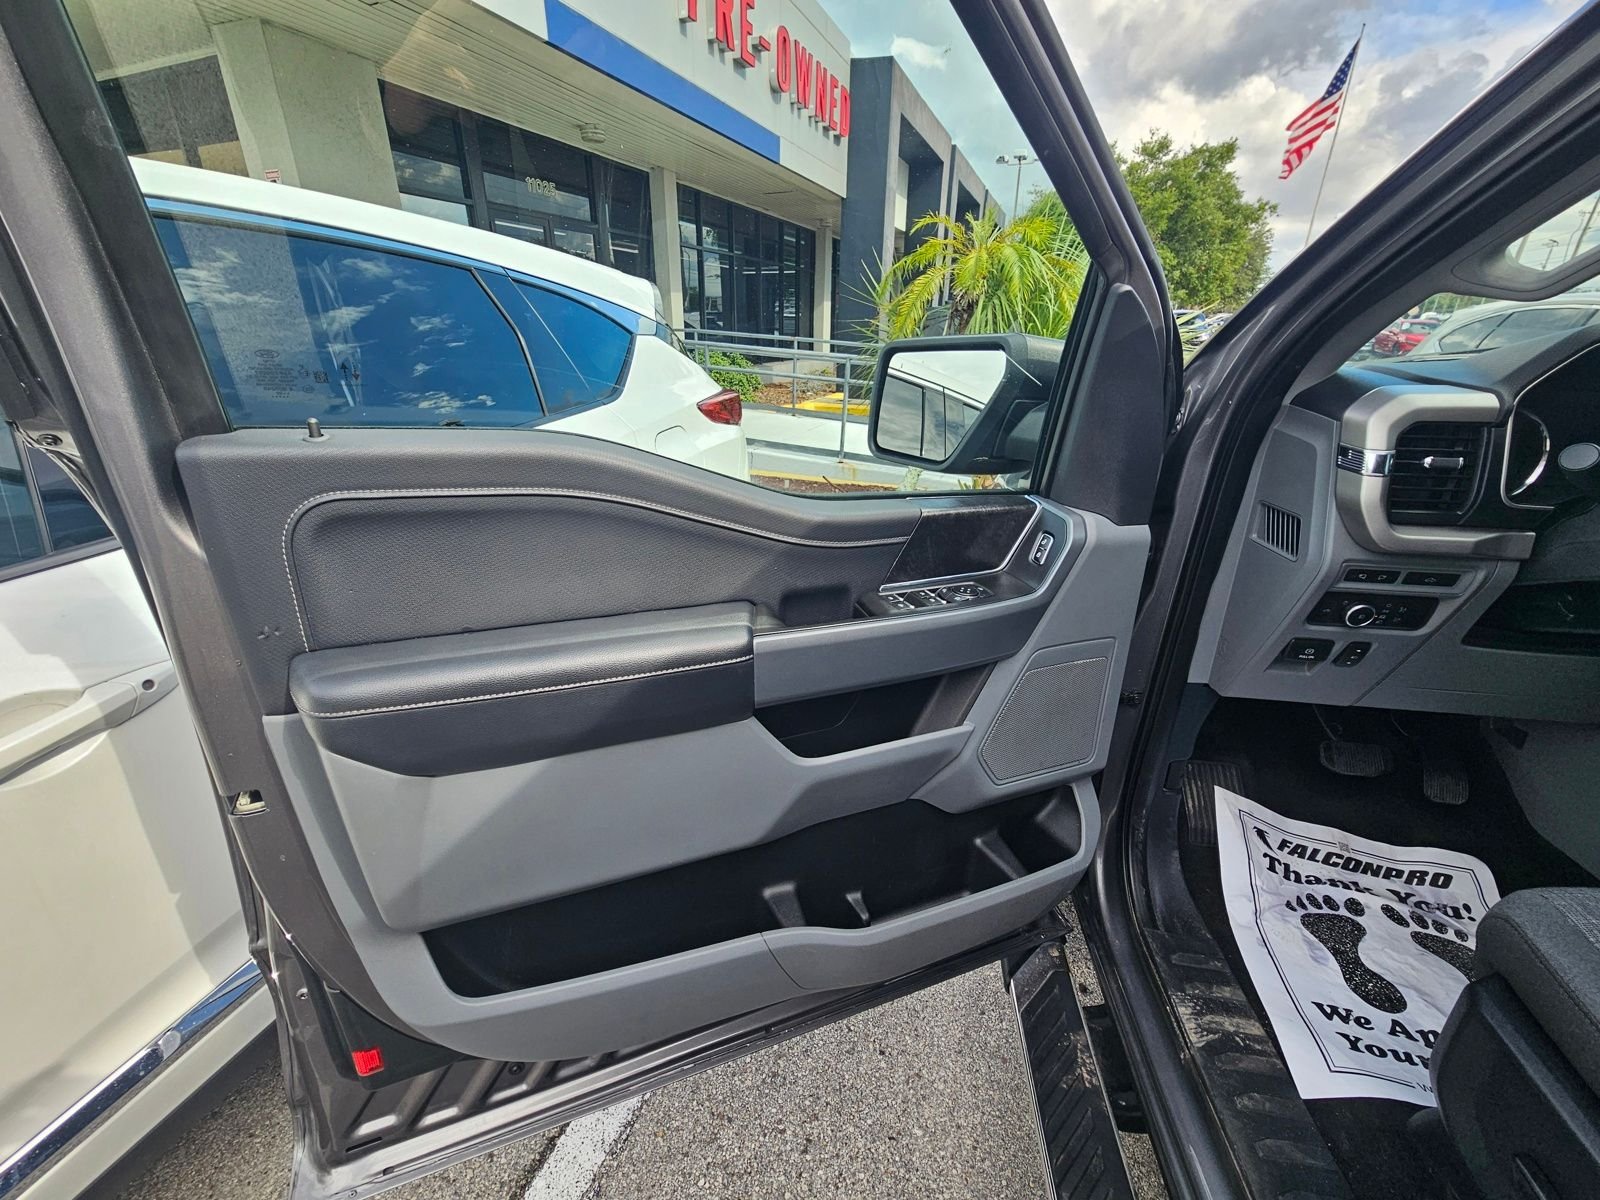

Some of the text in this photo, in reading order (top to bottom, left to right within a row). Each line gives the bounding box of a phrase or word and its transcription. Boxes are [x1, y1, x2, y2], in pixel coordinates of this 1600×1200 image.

[686, 0, 849, 137] RE-OWNED
[525, 176, 556, 197] 11025
[1262, 852, 1374, 894] Thank
[1276, 838, 1454, 889] FALCONPRO
[1310, 1000, 1375, 1031] We
